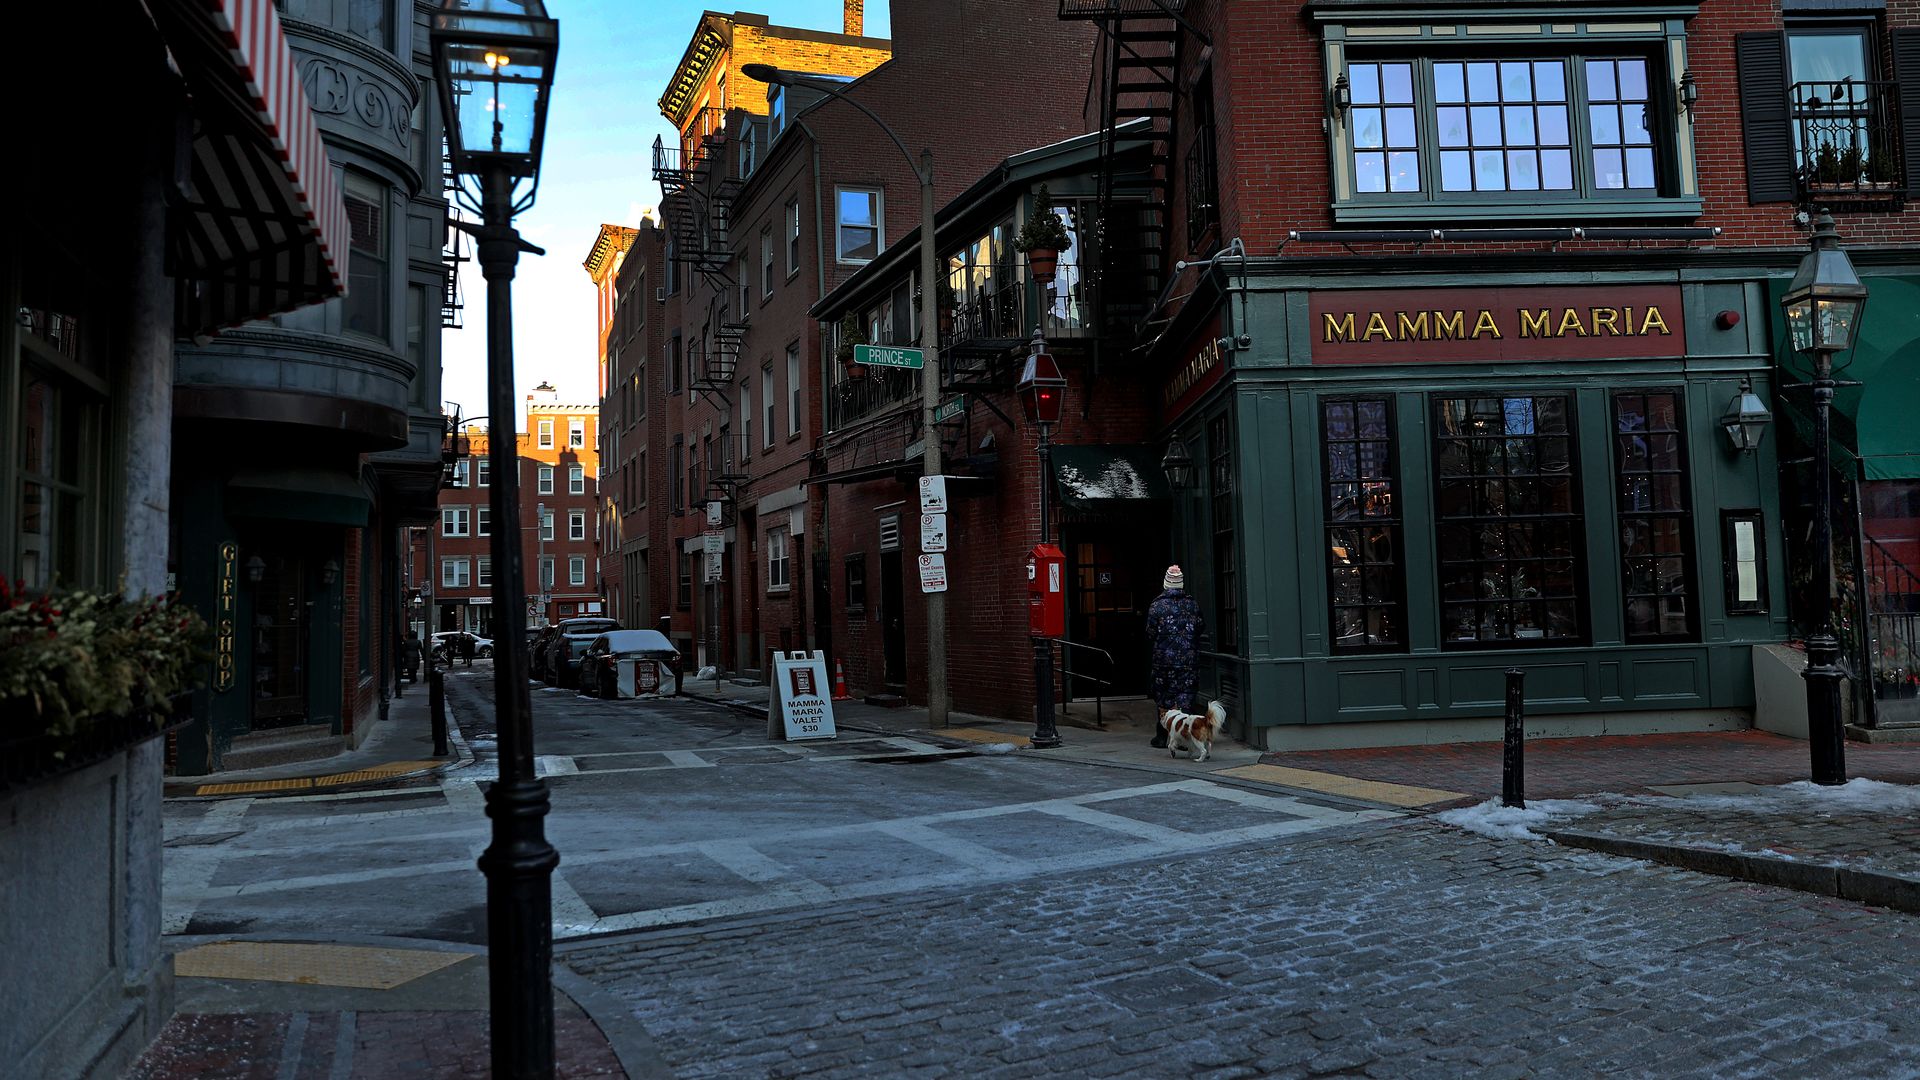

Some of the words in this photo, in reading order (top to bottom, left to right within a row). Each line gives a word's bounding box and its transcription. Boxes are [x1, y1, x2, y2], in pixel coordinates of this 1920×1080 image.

[1322, 309, 1503, 344] MAMMA
[1517, 305, 1672, 339] MARIA
[868, 348, 904, 365] PRINCE
[905, 357, 912, 366] ST
[1191, 337, 1220, 383] MARIA
[941, 401, 955, 418] NORTH
[221, 544, 235, 611] GIFT
[218, 619, 232, 687] SHOP
[787, 699, 826, 708] MAMMA
[792, 708, 824, 716] MARIA
[792, 716, 823, 724] VALET
